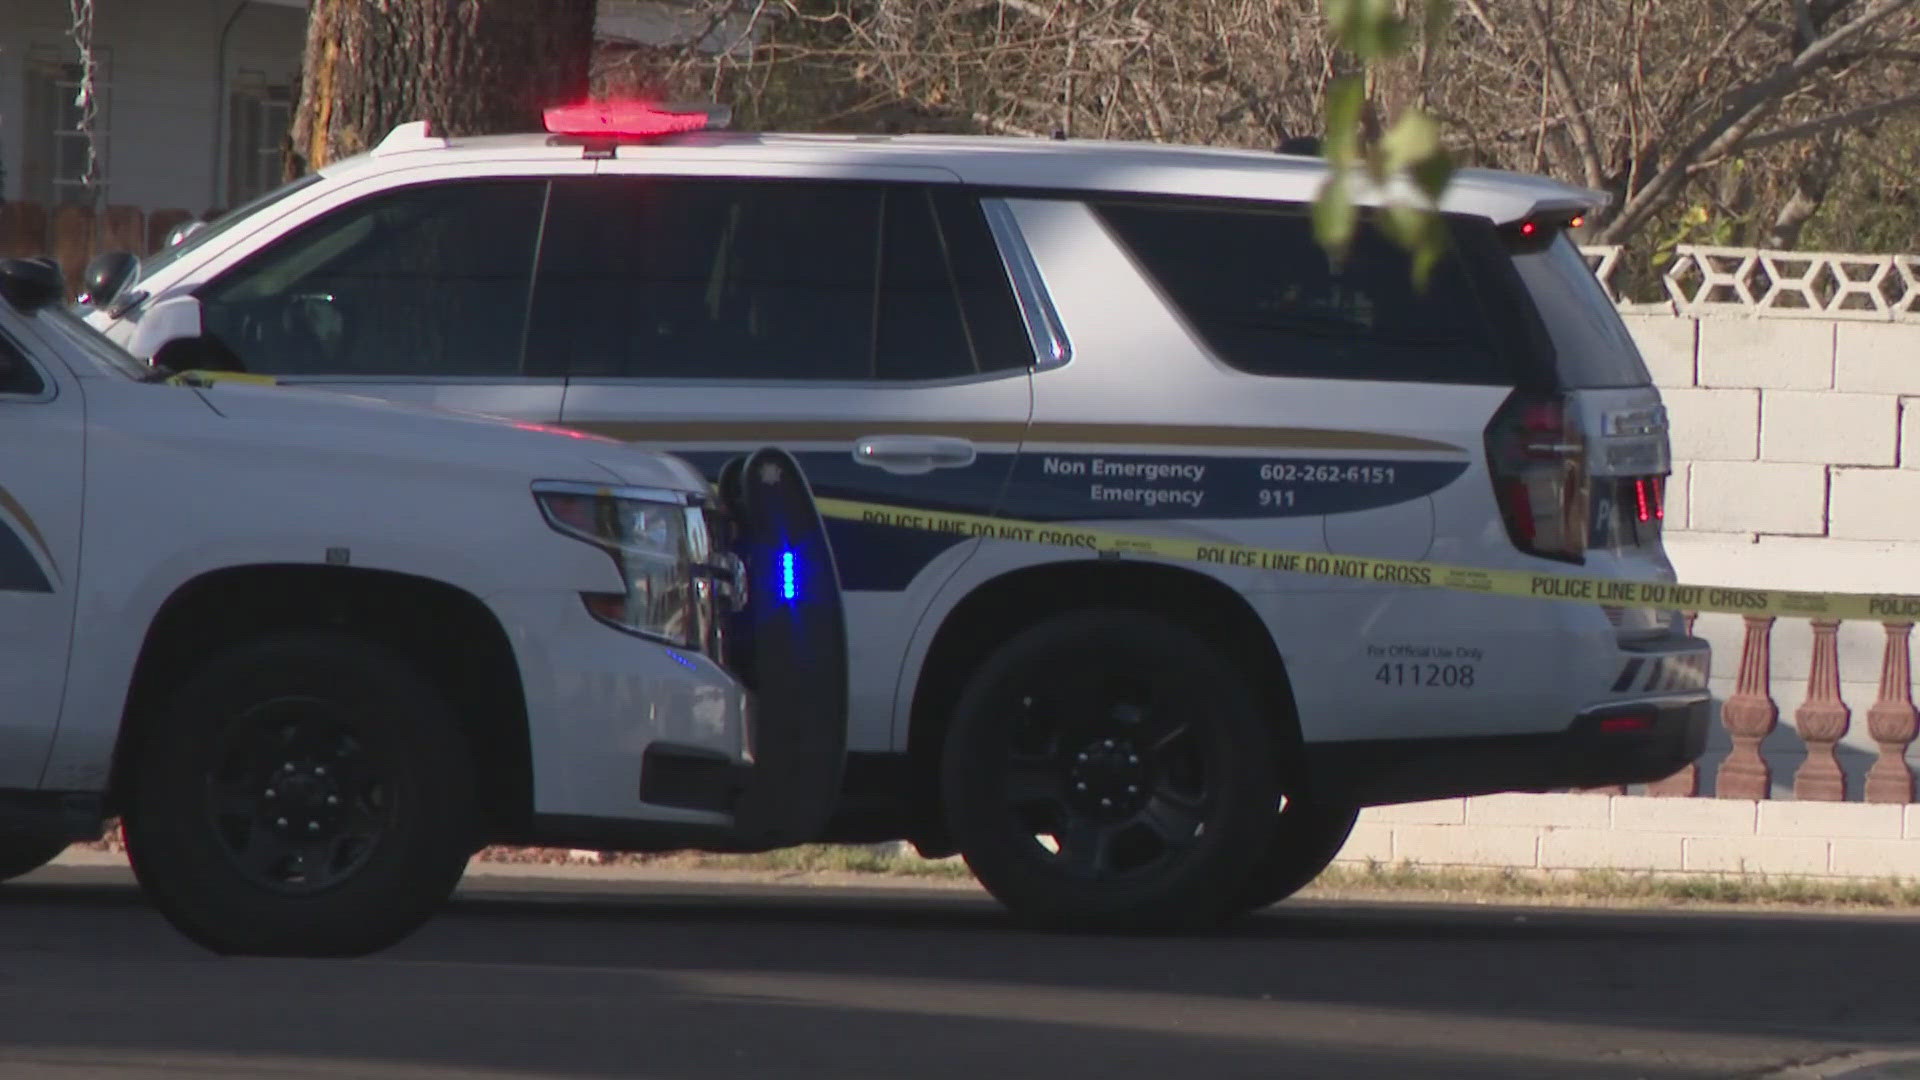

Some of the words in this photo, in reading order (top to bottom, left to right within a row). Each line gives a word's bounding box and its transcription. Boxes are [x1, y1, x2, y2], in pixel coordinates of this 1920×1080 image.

[1043, 457, 1085, 475] Non
[1092, 459, 1205, 480] Emergency
[1260, 464, 1396, 484] 602-262-6151
[1090, 485, 1204, 507] Emergency
[1259, 489, 1296, 507] 911
[863, 510, 922, 529] POLICE
[928, 517, 967, 535] LINE
[971, 522, 995, 539] DO
[999, 526, 1034, 543] NOT
[1039, 530, 1097, 551] CROSS
[1197, 546, 1256, 567] POLICE
[1262, 552, 1300, 571] LINE
[1305, 556, 1330, 575] DO
[1334, 559, 1369, 579] NOT
[1374, 563, 1432, 585] CROSS
[1532, 576, 1592, 599] POLICE
[1597, 581, 1636, 601] LINE
[1641, 584, 1665, 603] DO
[1669, 586, 1705, 605] NOT
[1709, 588, 1769, 609] CROSS
[1367, 644, 1386, 657] For
[1389, 644, 1430, 658] Official
[1433, 647, 1453, 658] Use
[1456, 647, 1486, 661] Only
[1374, 662, 1475, 688] 411208
